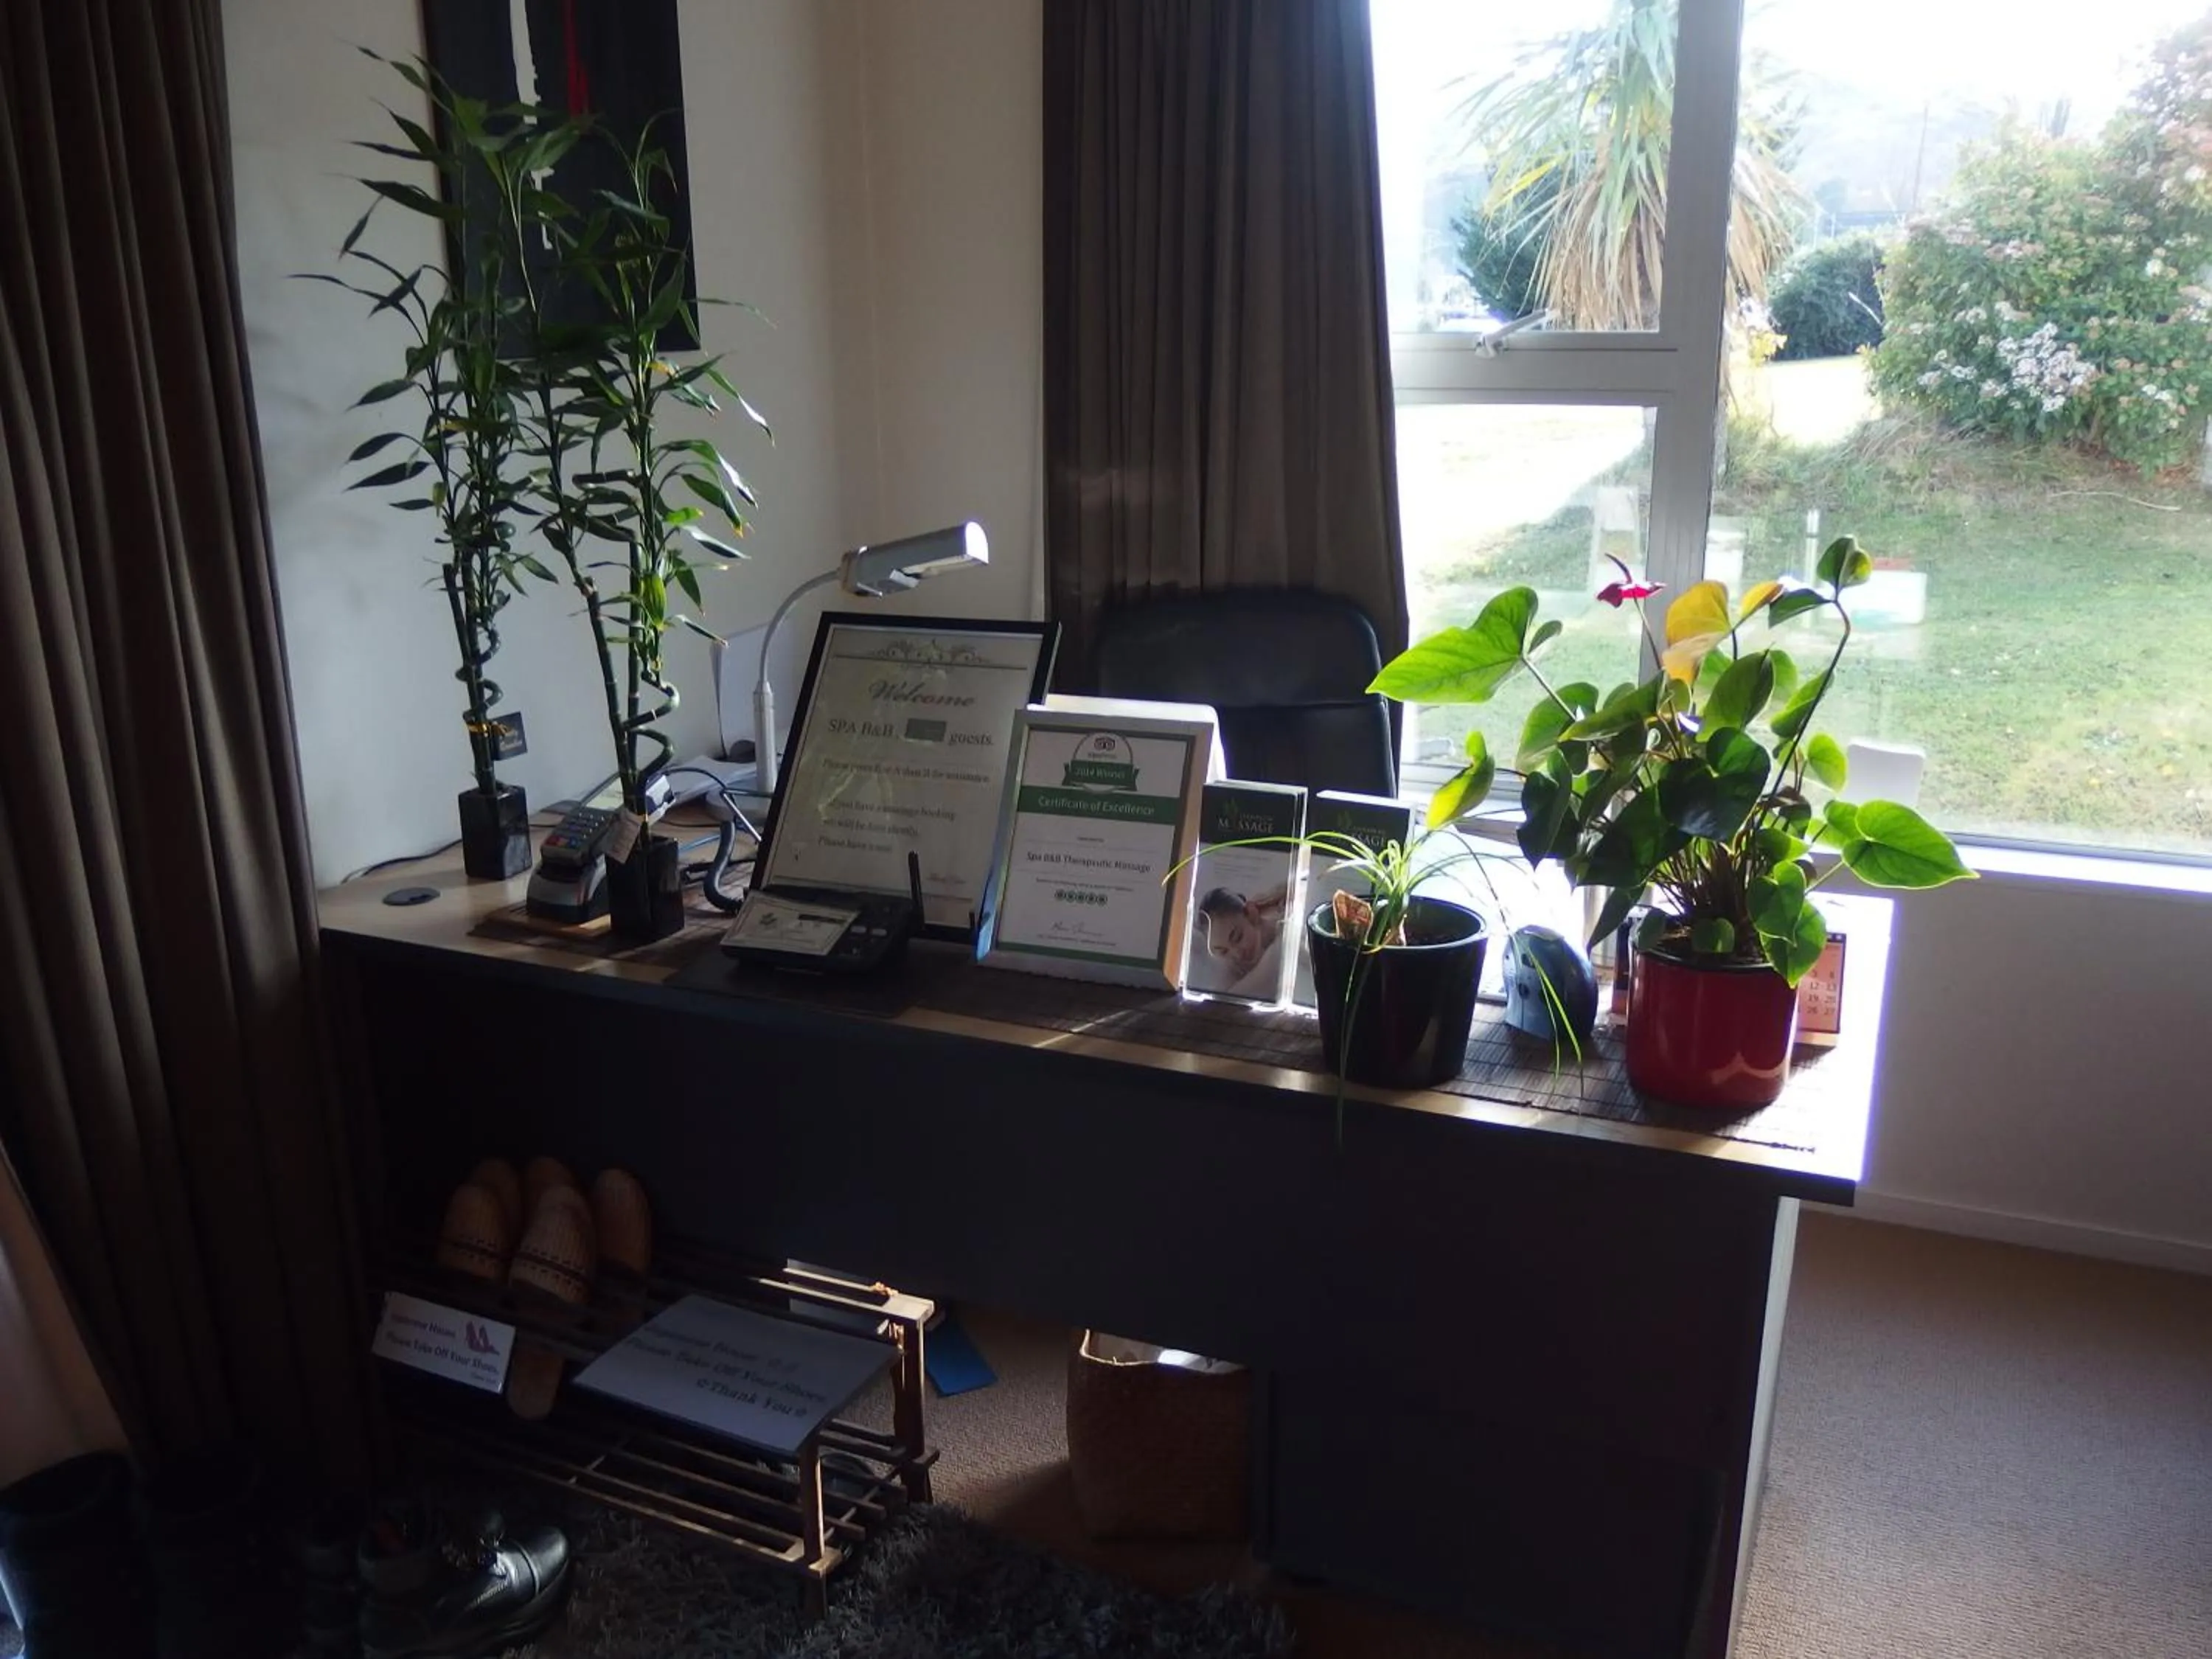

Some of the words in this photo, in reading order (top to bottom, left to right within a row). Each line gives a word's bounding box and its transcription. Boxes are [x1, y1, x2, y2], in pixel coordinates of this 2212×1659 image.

[869, 680, 975, 708] Welcome
[827, 718, 857, 734] SPA
[1038, 796, 1088, 810] Certificate
[1089, 801, 1101, 813] of
[1102, 801, 1155, 816] Excellence
[1026, 851, 1043, 863] Spa
[1044, 853, 1062, 863] B&B
[1063, 854, 1112, 869] Therapeutic
[1113, 859, 1152, 873] Massage
[434, 1343, 450, 1359] Off
[713, 1361, 743, 1378] Off
[705, 1380, 757, 1405] Thank
[762, 1395, 793, 1416] You
